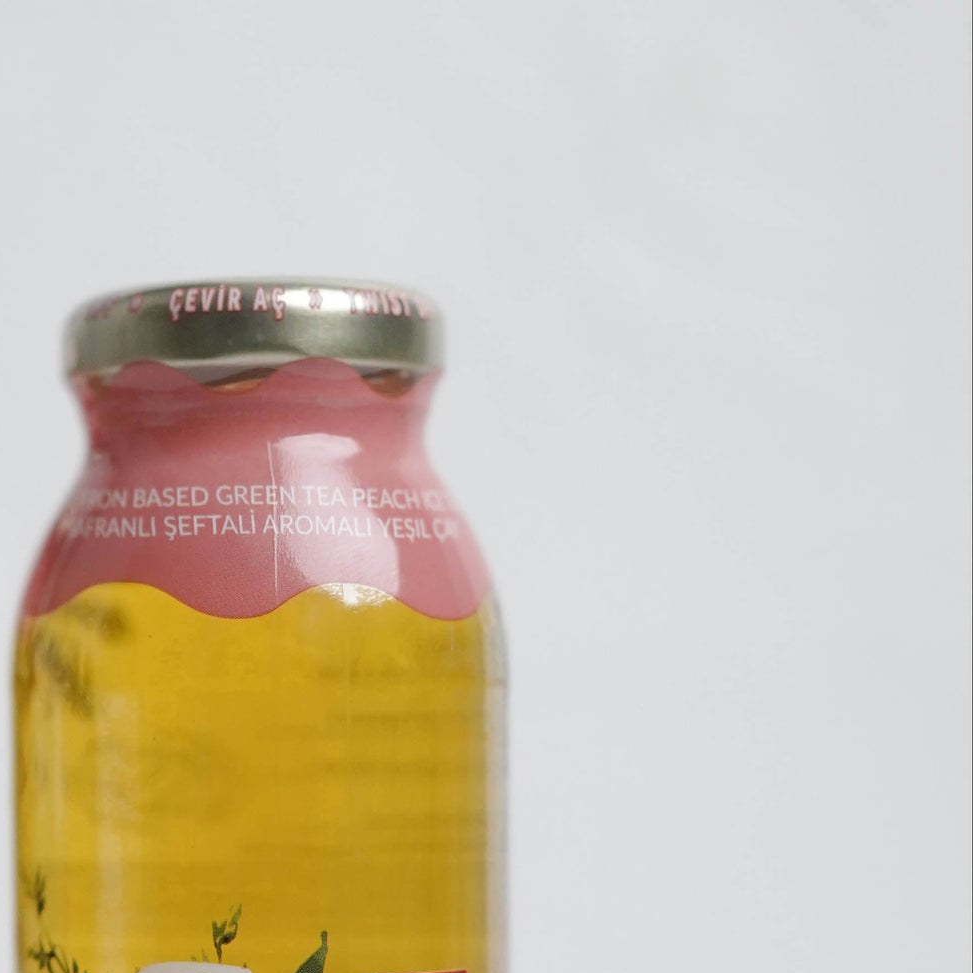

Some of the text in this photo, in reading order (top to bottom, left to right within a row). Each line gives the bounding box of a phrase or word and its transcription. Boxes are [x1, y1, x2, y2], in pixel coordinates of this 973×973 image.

[169, 283, 242, 322] ÇEVİR
[252, 284, 285, 321] AÇ
[133, 485, 209, 509] BASED
[216, 484, 295, 505] GREEN
[302, 485, 347, 507] TEA
[353, 487, 420, 511] PEACH
[164, 509, 256, 541] ŞEFTALİ
[263, 513, 372, 538] AROMALI
